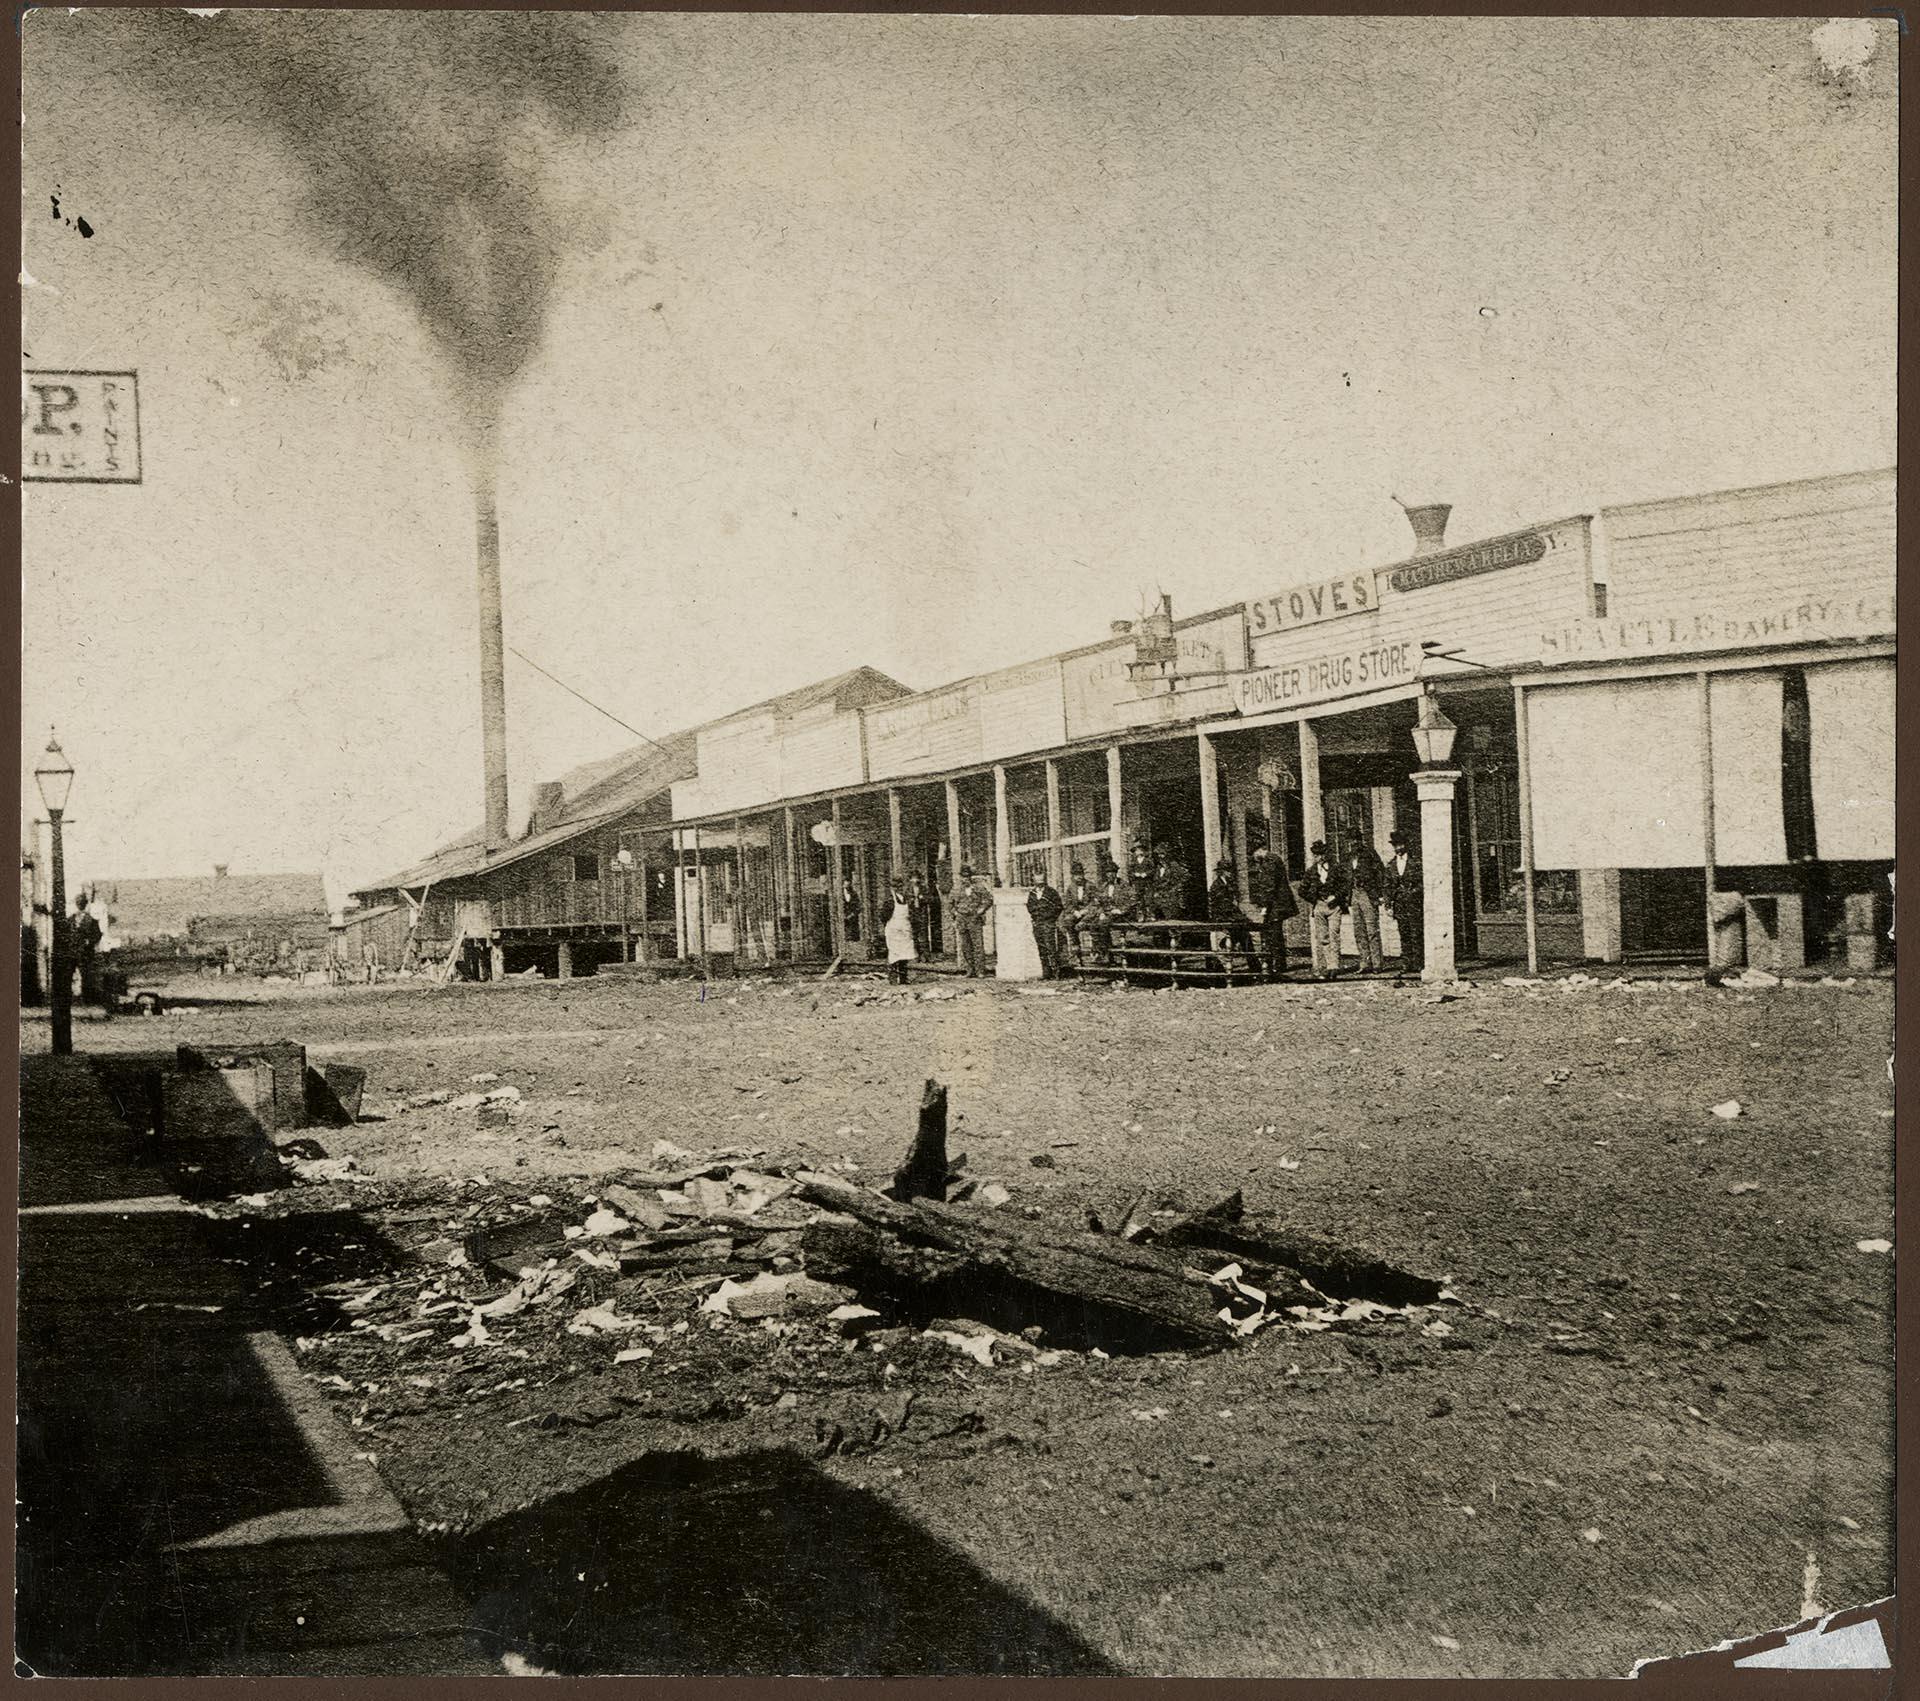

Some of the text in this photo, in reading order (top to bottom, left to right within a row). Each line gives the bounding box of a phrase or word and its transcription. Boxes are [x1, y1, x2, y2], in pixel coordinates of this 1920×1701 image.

[1254, 576, 1367, 629] STOVES
[1540, 615, 1714, 653] SEATTLE
[1724, 599, 1833, 640] BAKERY
[1242, 670, 1301, 706] PIONEER
[1309, 656, 1352, 692] DRUG
